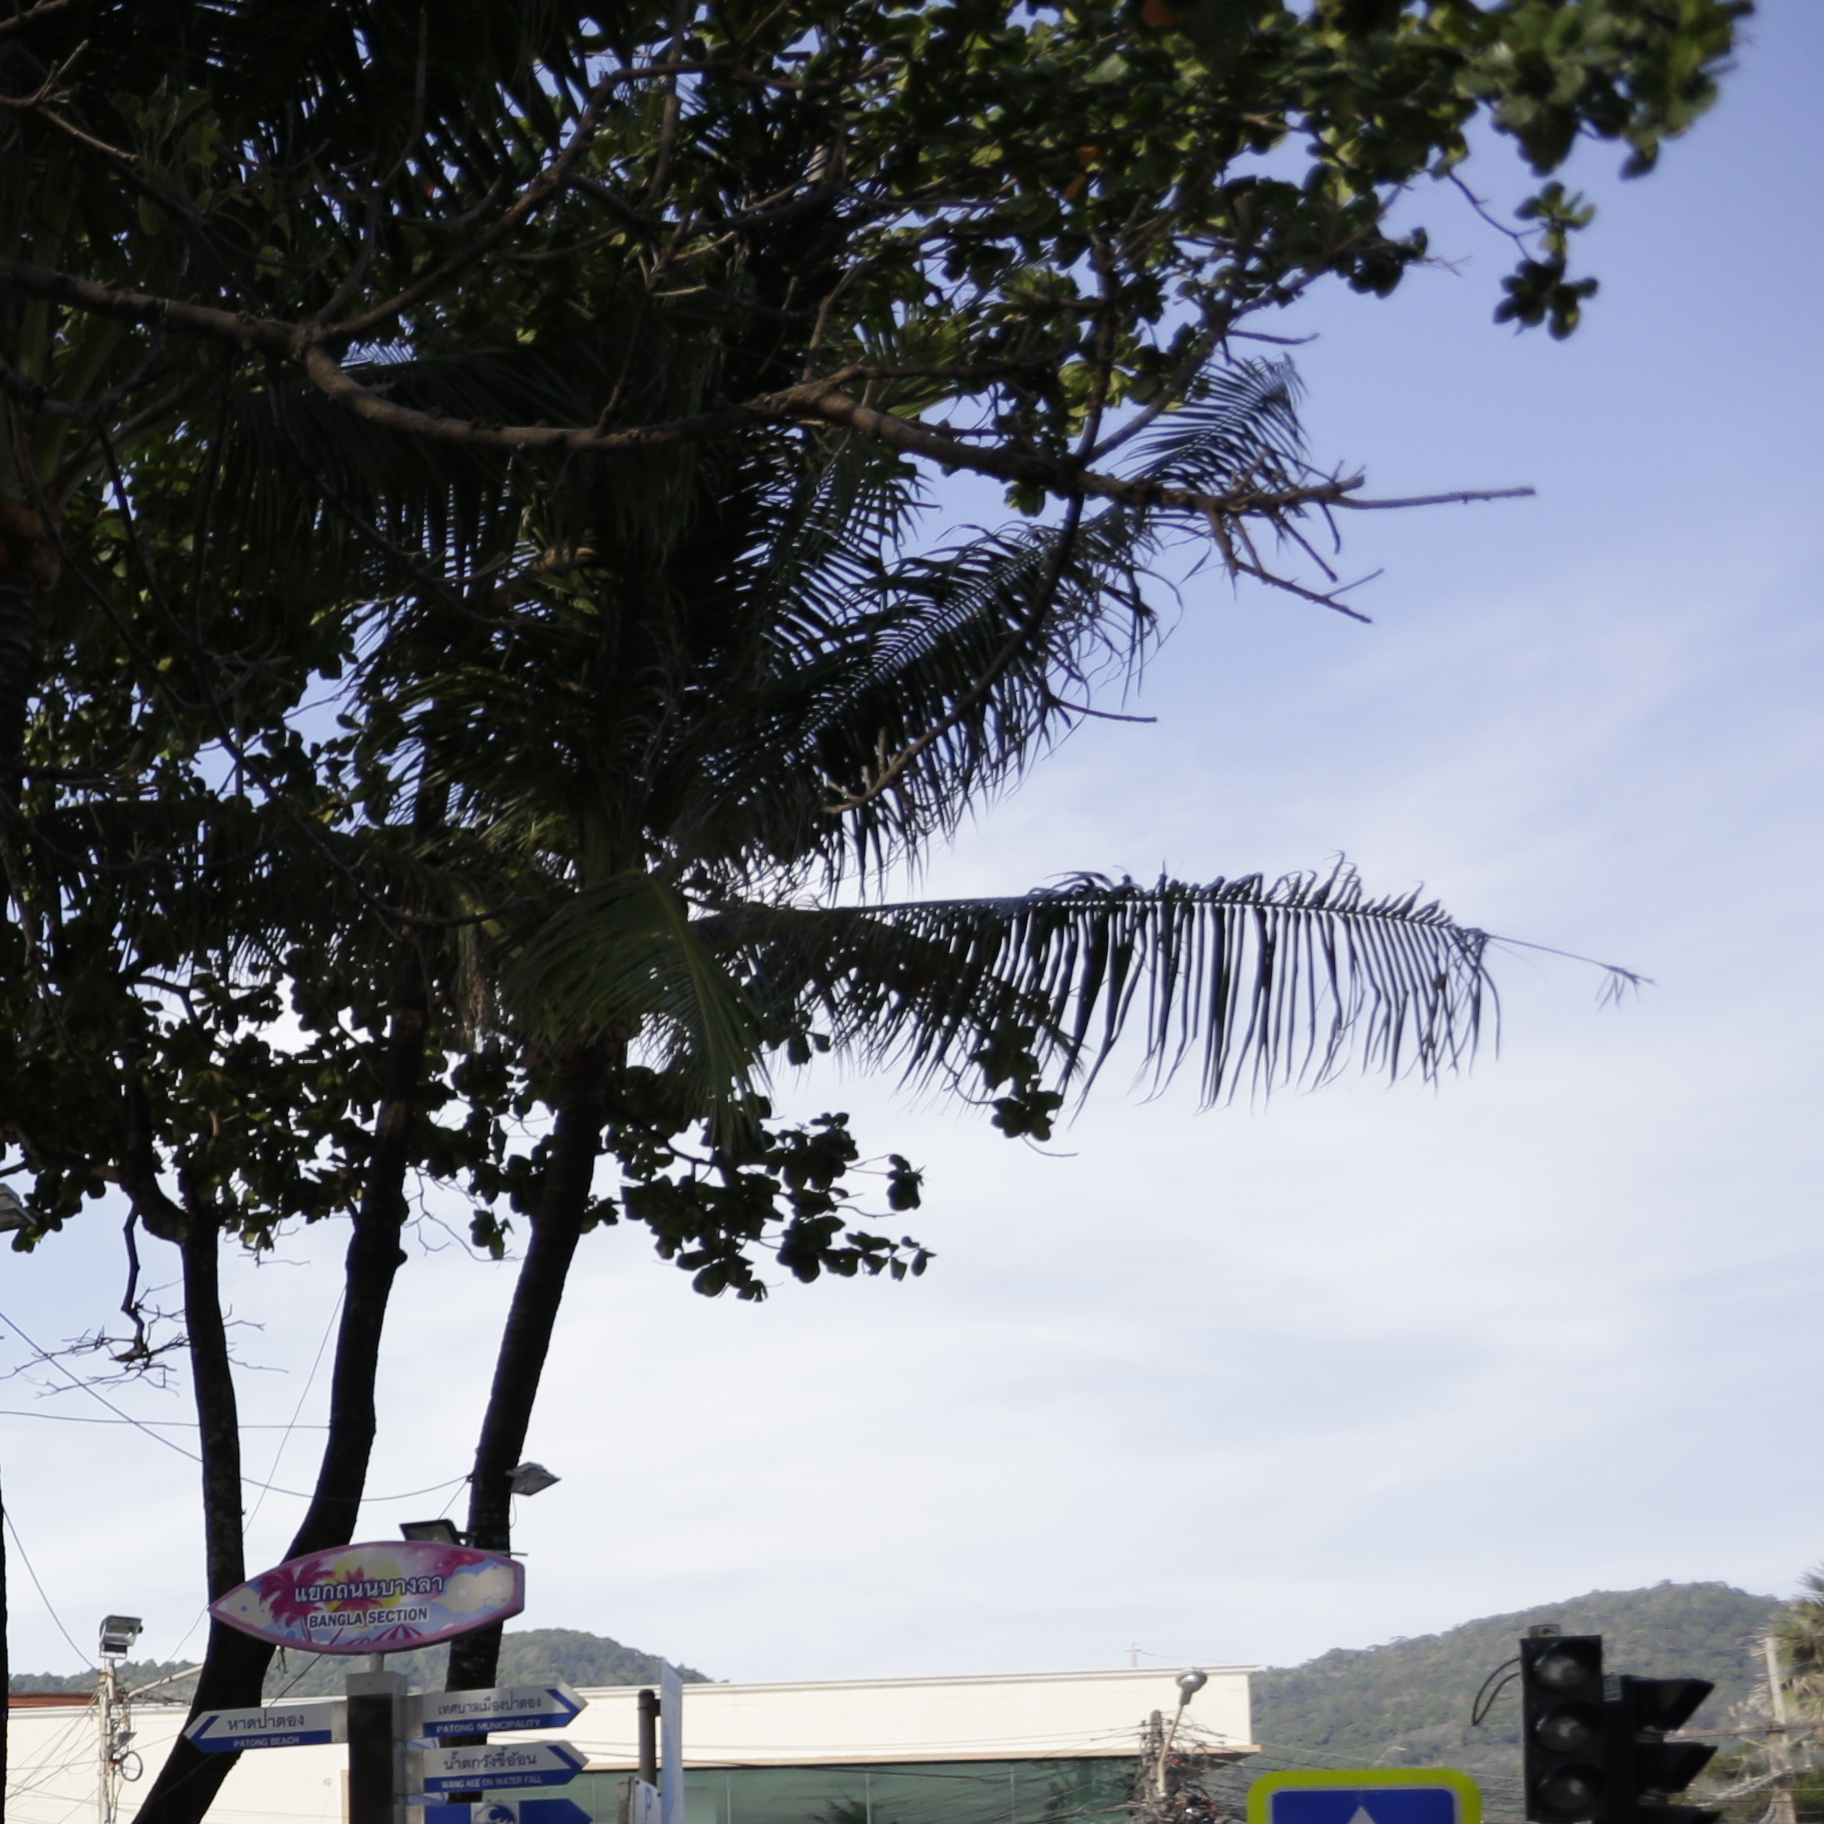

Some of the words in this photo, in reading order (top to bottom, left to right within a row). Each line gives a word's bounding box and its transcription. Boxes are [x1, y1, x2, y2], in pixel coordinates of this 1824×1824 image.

[294, 1575, 444, 1603] แยกถนนบางลา
[308, 1610, 363, 1629] BANGLA
[367, 1607, 428, 1625] SECTION
[436, 1722, 474, 1734] PATONG
[477, 1719, 541, 1731] MUNICIPALITY
[233, 1738, 268, 1748] PATONG
[270, 1736, 299, 1745] BEACH
